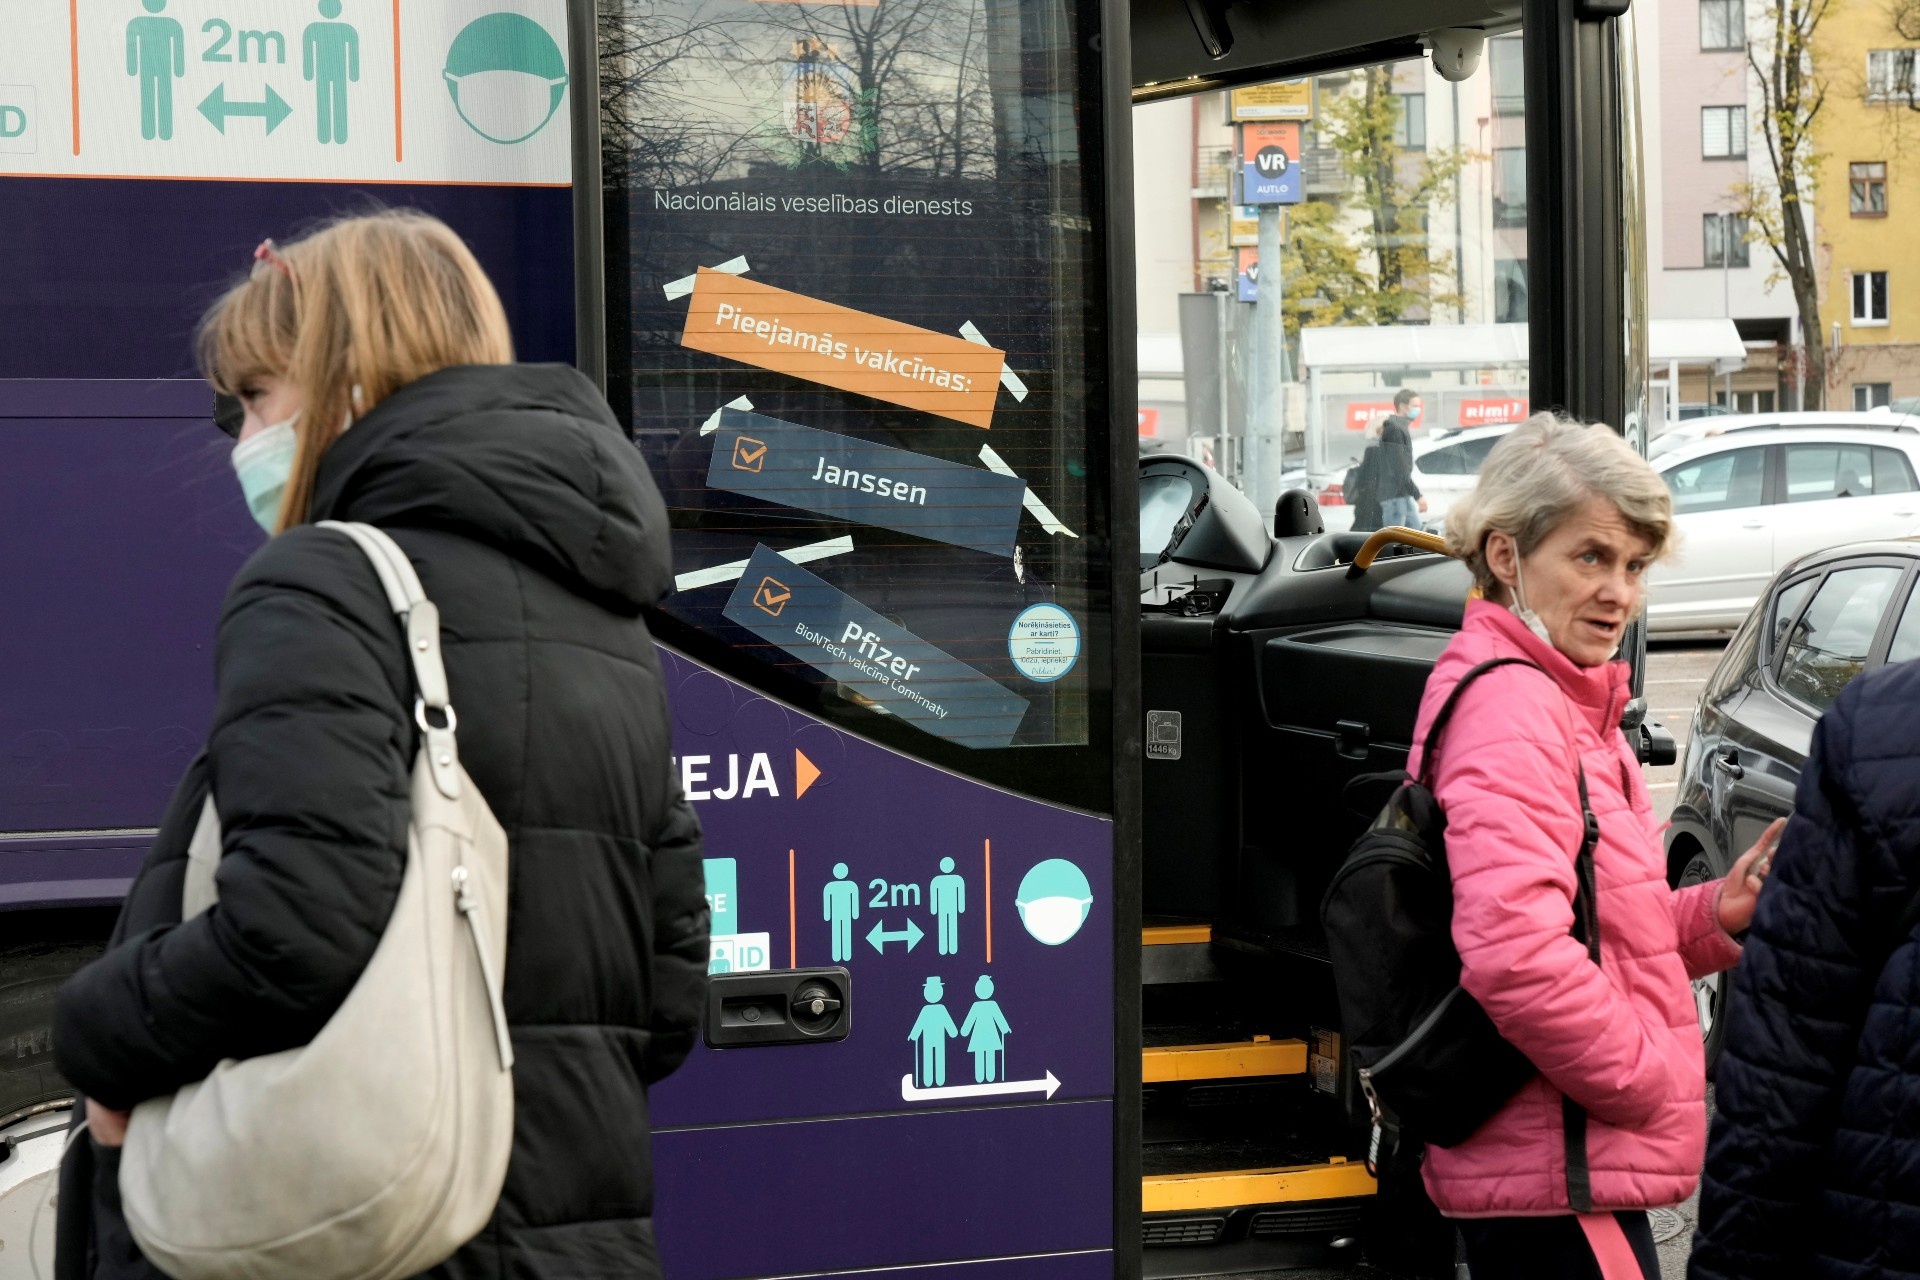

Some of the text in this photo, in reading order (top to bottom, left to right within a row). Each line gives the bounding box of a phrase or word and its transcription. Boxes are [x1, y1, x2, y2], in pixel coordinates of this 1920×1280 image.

[202, 18, 286, 64] 2m
[1258, 153, 1286, 171] VR
[654, 190, 973, 215] Nacionālais veselības dienests
[716, 302, 973, 394] Pieejamās vakcīnas:
[812, 456, 928, 507] Janssen
[1018, 621, 1071, 630] Norēķināsieties
[795, 622, 949, 720] BioNTech vakcīna Comirnaty
[839, 621, 922, 682] Pfizer
[672, 752, 780, 801] EJA
[868, 878, 921, 909] 2m
[739, 946, 764, 969] ID
